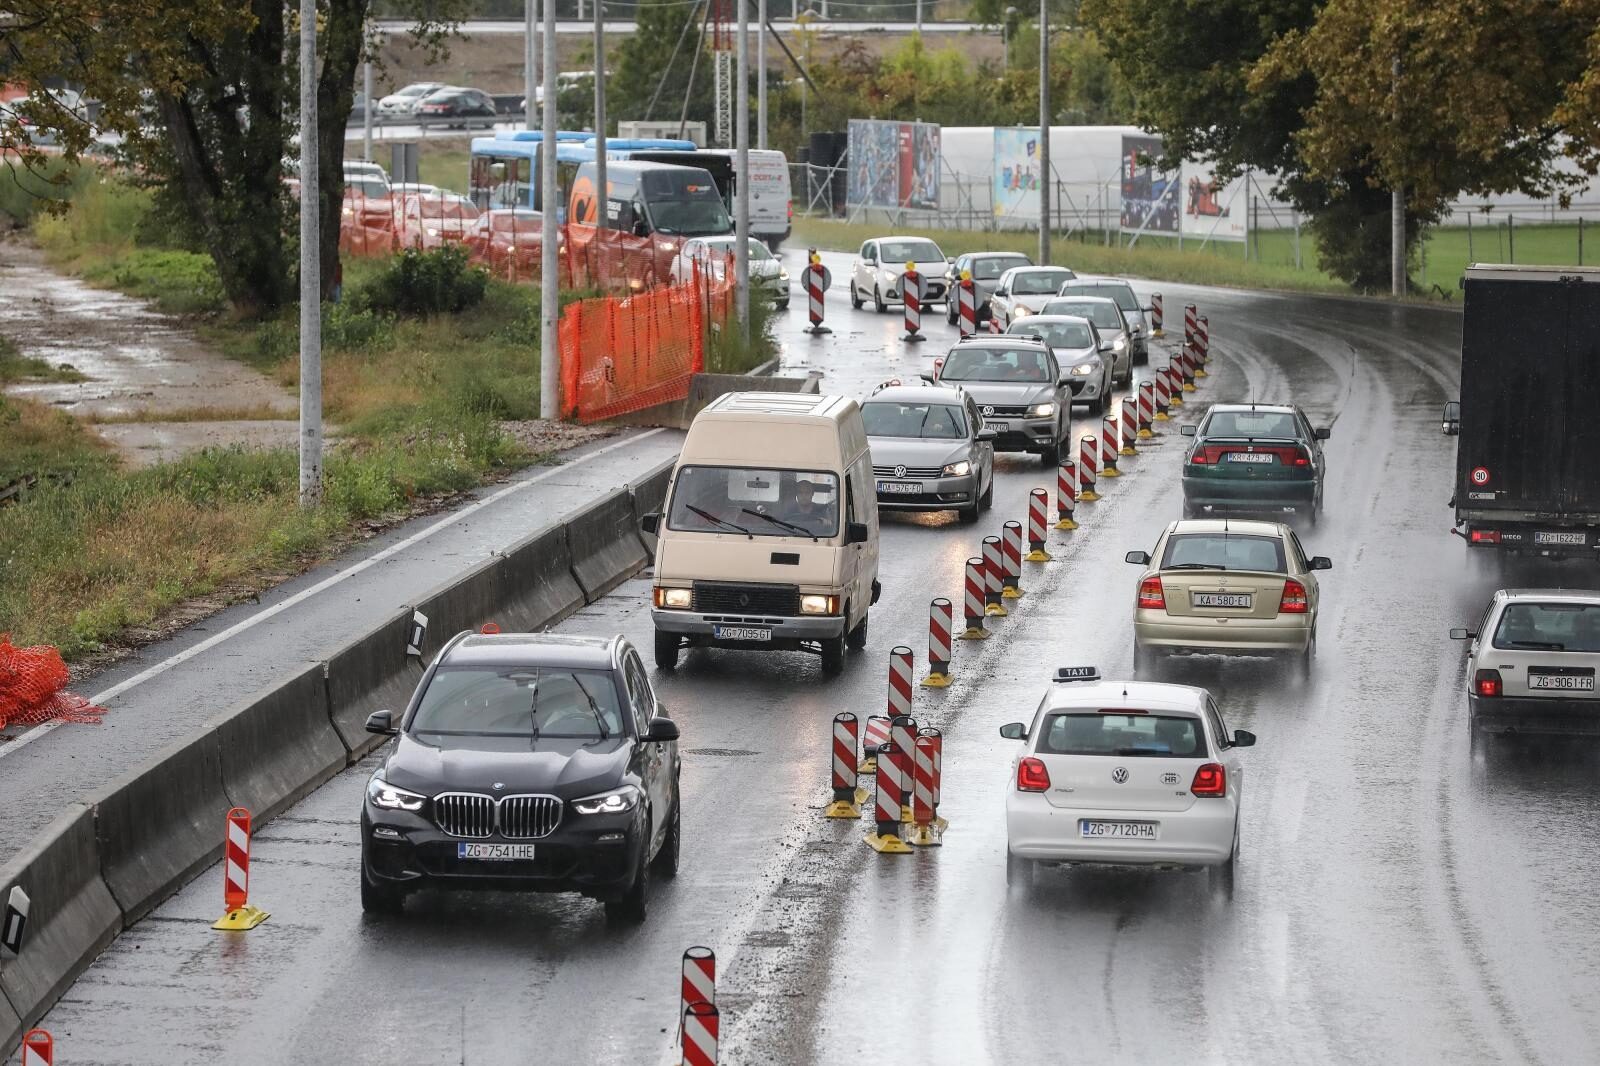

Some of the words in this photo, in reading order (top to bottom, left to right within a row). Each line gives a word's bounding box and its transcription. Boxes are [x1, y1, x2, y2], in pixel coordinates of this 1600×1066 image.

[1475, 471, 1486, 480] 90
[1541, 533, 1551, 542] ZG
[1200, 595, 1211, 605] KA
[721, 628, 732, 638] ZG
[1065, 668, 1089, 676] TAXI
[1536, 676, 1549, 687] ZG
[1090, 823, 1104, 835] ZG
[466, 844, 481, 857] ZG
